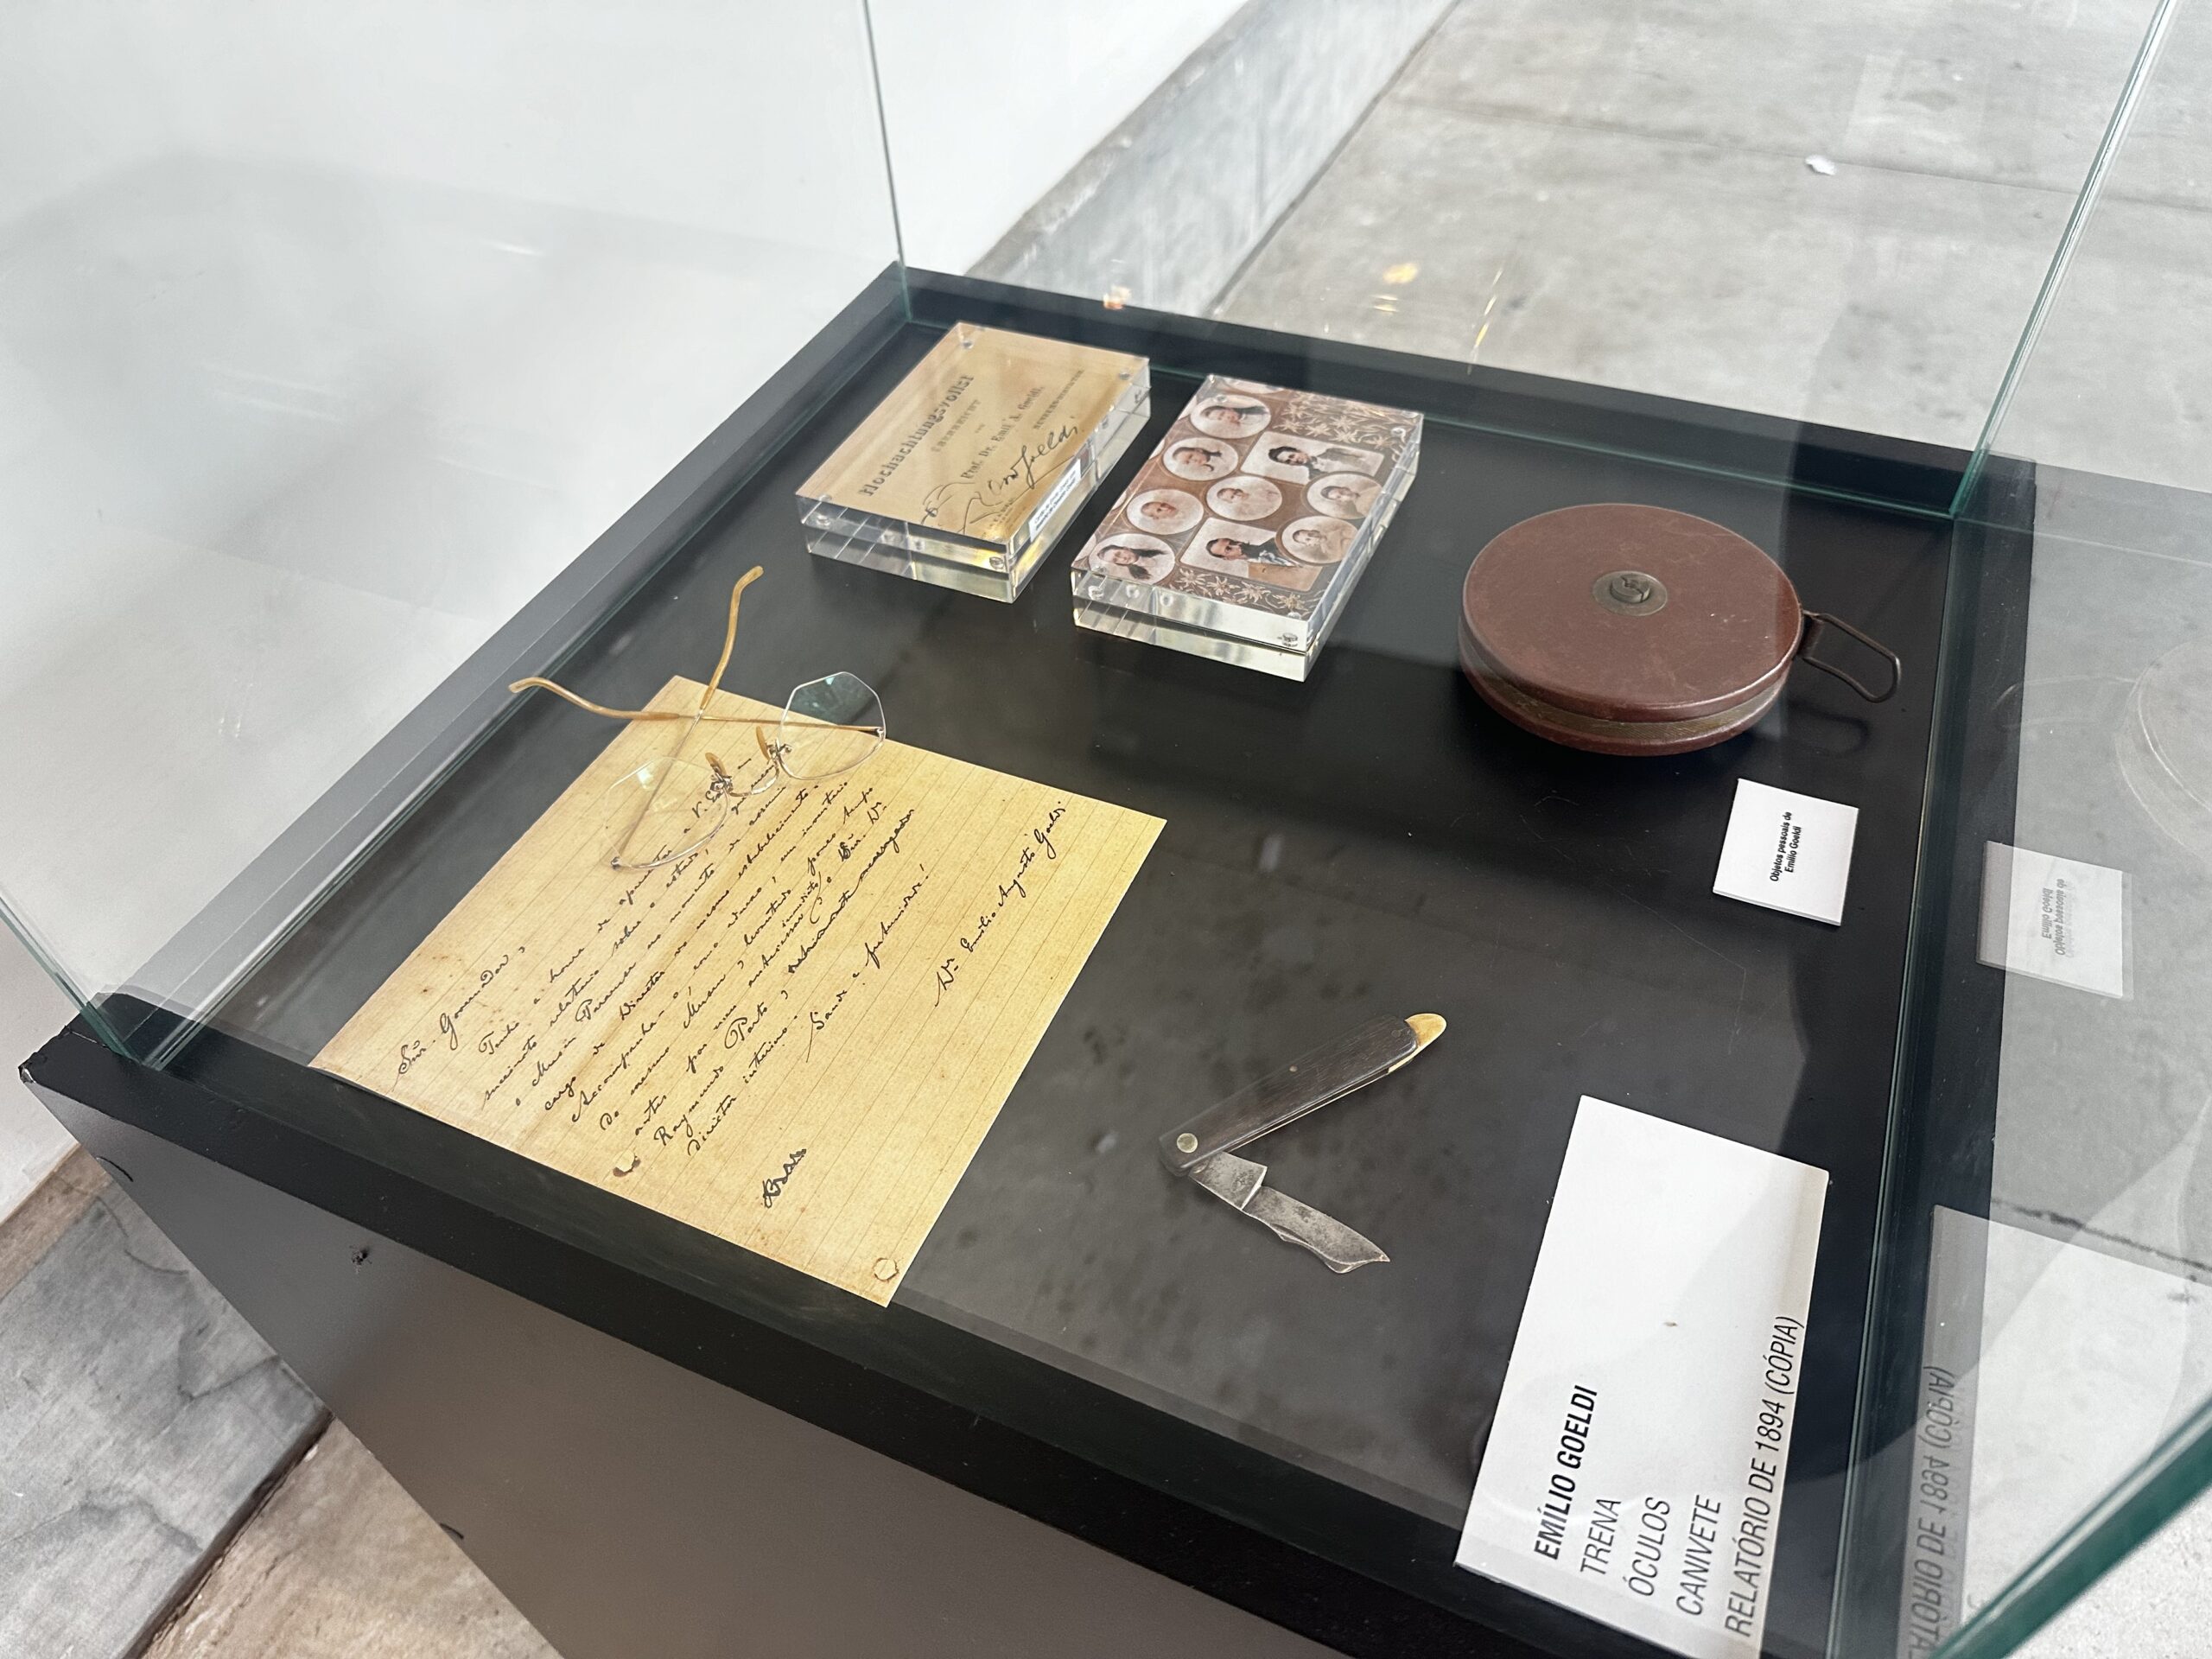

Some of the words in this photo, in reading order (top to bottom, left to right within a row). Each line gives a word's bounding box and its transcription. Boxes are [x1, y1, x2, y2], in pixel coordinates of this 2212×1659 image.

[1033, 801, 1066, 859] Goeldi
[1777, 822, 1790, 854] pessoais
[1782, 811, 1792, 821] de
[1789, 825, 1802, 849] Goeldi
[669, 861, 715, 924] momento
[1770, 854, 1783, 881] Objetos
[611, 920, 642, 957] sobre
[692, 942, 719, 976] como
[478, 1018, 520, 1056] Tenho
[549, 947, 586, 984] honra
[597, 918, 612, 934] de
[544, 1076, 577, 1111] cargo
[592, 1041, 606, 1058] de
[696, 889, 730, 931] mesmo
[630, 1046, 671, 1096] mesmo
[634, 1094, 667, 1136] antes
[652, 1065, 724, 1147] Raymundo
[1763, 1316, 1805, 1395] (CÓPIA)
[1755, 1398, 1787, 1452] 1894
[1534, 1473, 1576, 1560] EMÍLIO
[1556, 1384, 1598, 1469] GOELDI
[1748, 1458, 1777, 1493] DE
[1580, 1497, 1622, 1575] TRENA
[1622, 1497, 1670, 1596] ÓCULOS
[1675, 1495, 1721, 1616] CANIVETE
[1725, 1497, 1771, 1637] RELATÓRIO
